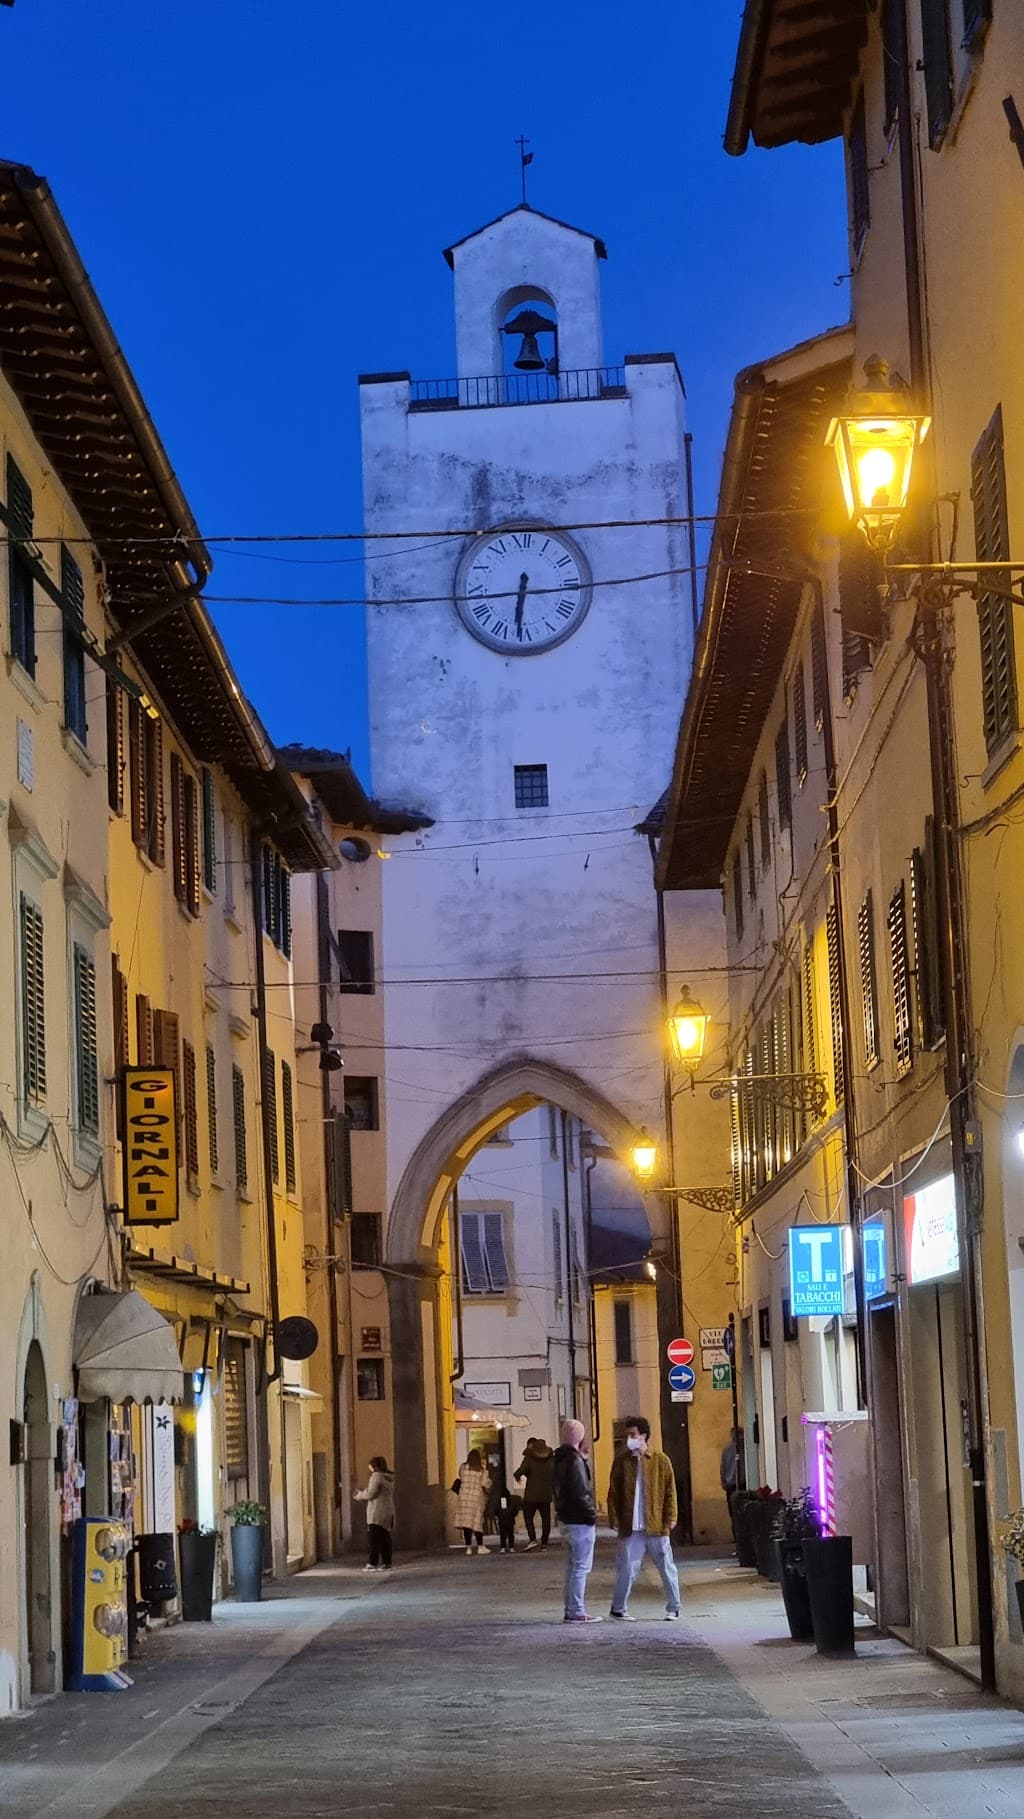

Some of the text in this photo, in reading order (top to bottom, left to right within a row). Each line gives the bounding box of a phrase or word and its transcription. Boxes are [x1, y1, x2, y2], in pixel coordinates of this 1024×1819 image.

[511, 534, 532, 549] XII
[541, 539, 550, 553] I
[556, 554, 572, 569] II
[472, 603, 493, 627] VIII
[556, 600, 576, 620] IIII
[491, 620, 508, 640] VII
[130, 1080, 169, 1211] GIORNALI
[799, 1232, 833, 1282] T
[807, 1283, 822, 1291] SALI
[795, 1291, 841, 1303] TABACCHI
[795, 1305, 816, 1313] VALORI
